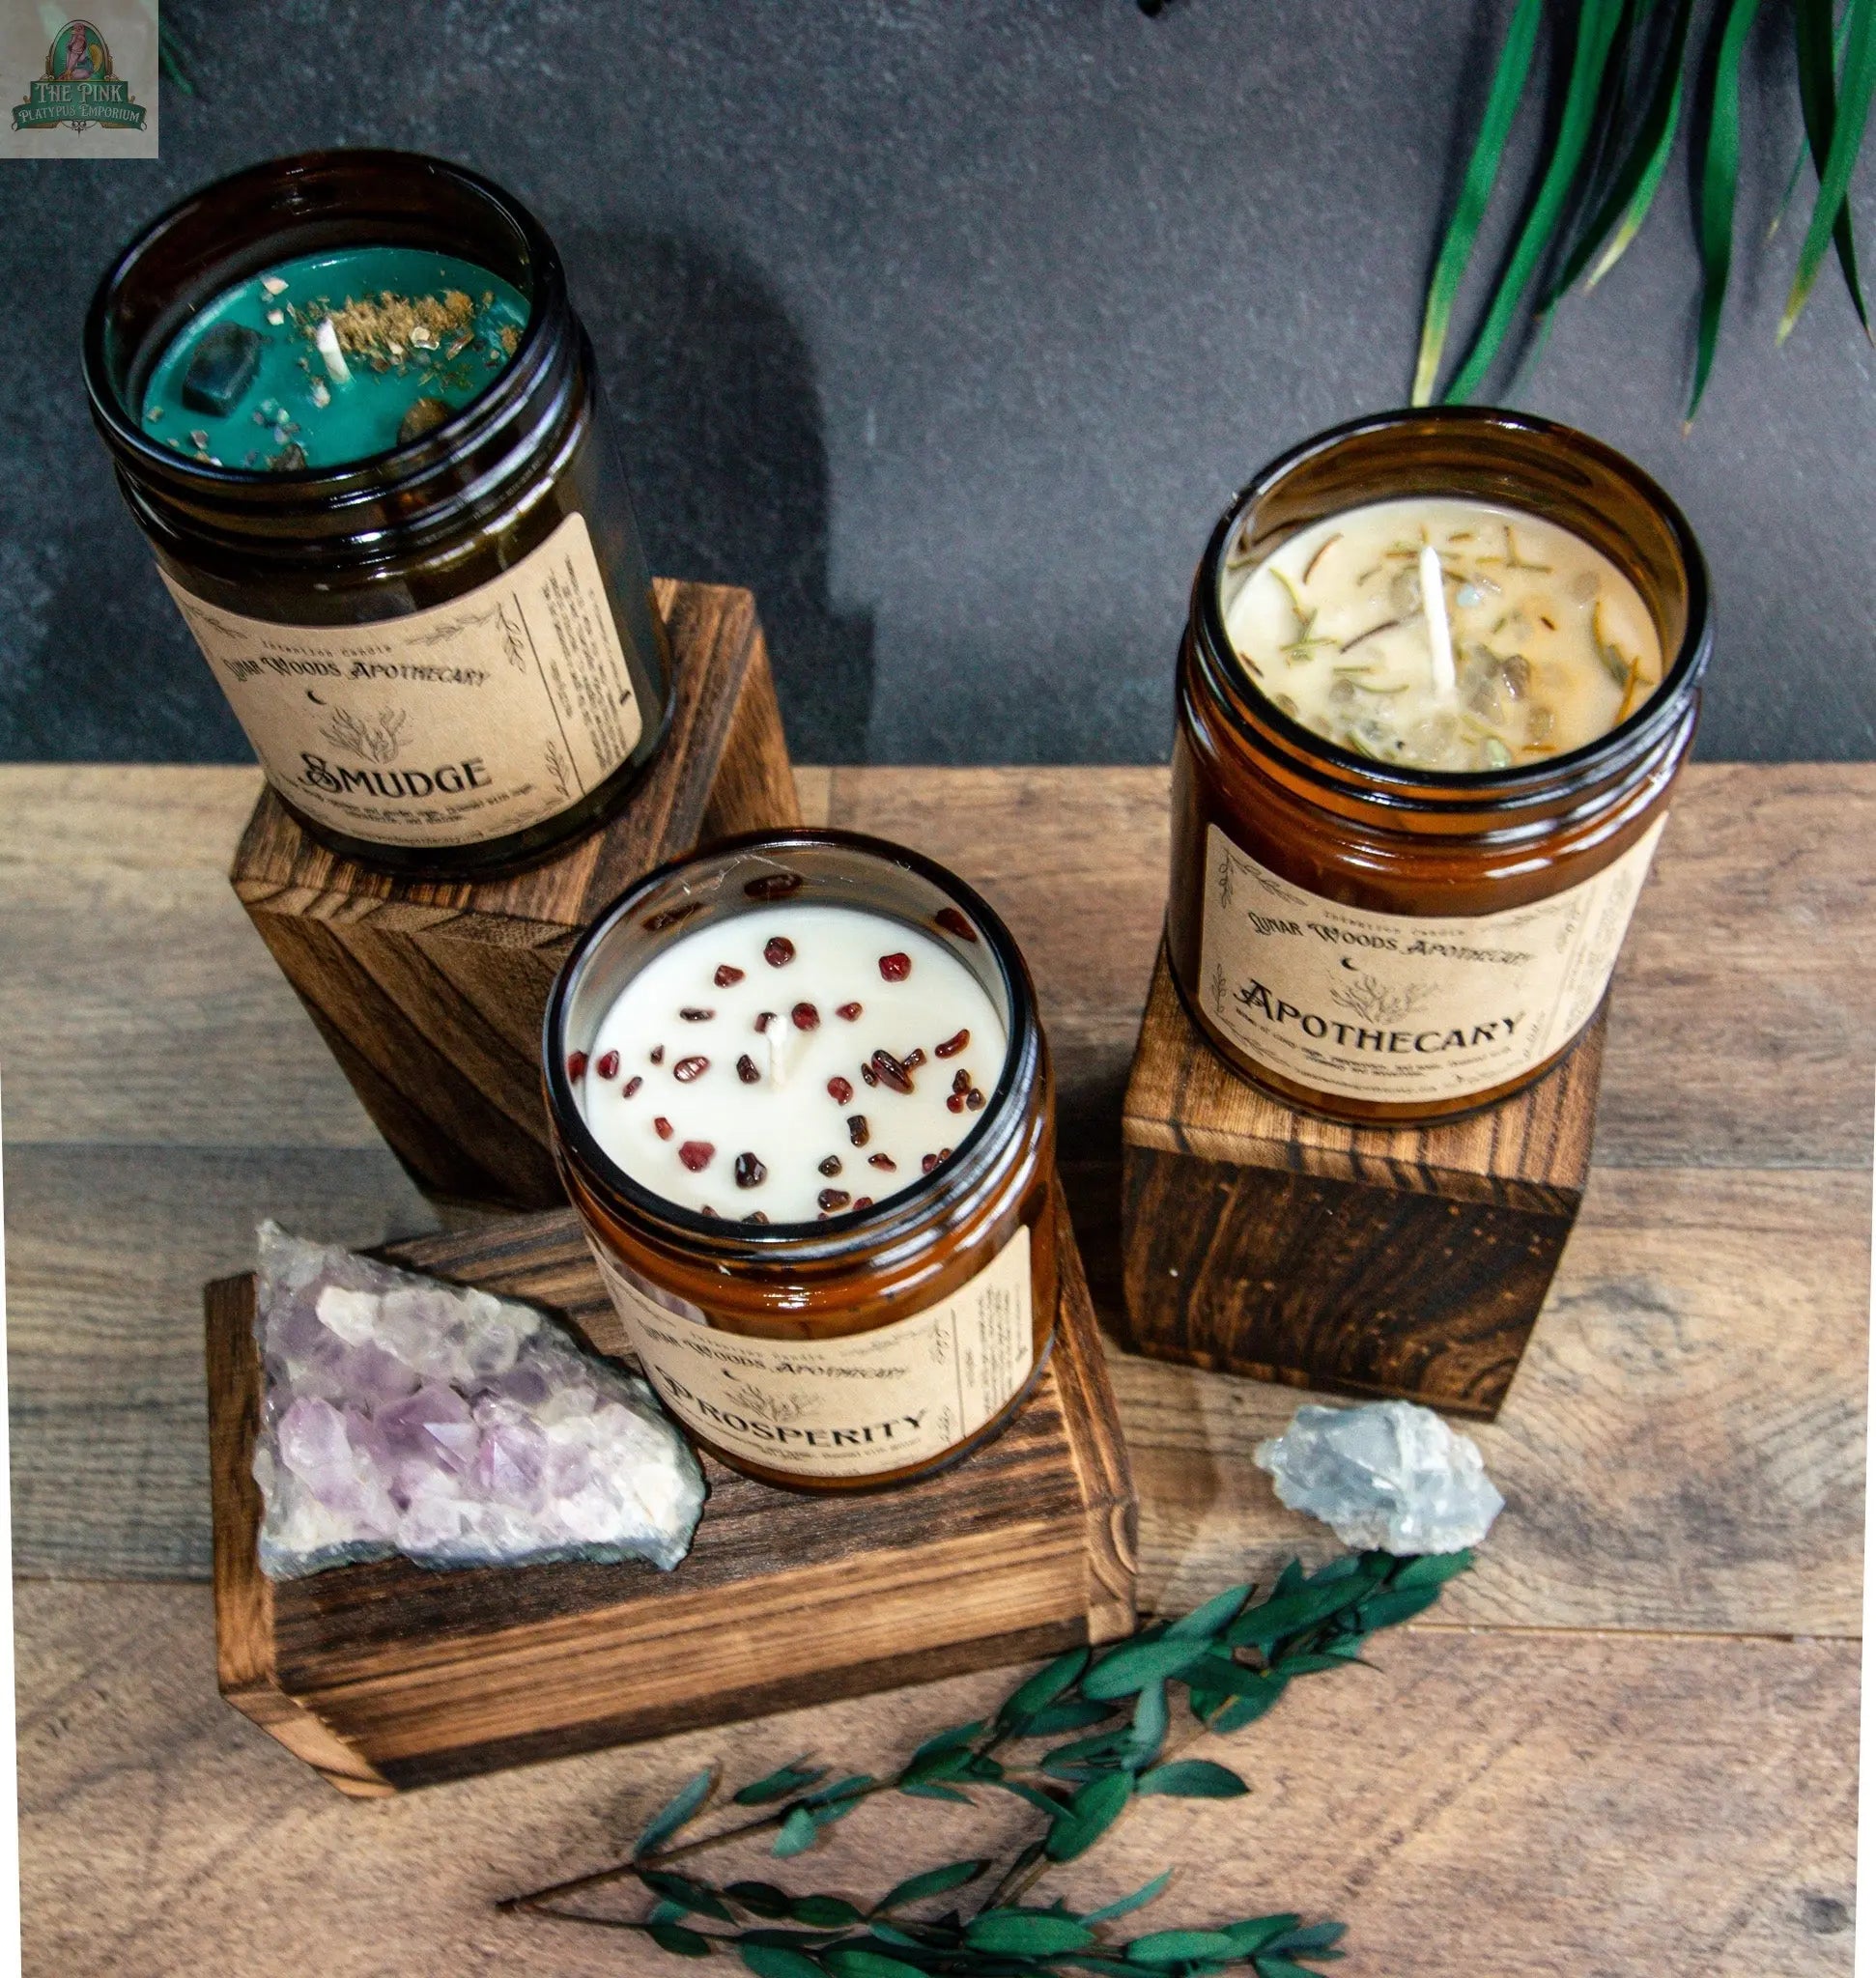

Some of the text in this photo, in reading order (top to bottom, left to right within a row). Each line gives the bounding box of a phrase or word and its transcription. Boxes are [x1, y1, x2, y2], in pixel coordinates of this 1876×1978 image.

[297, 750, 493, 799] SMUDGE
[1247, 911, 1305, 937] LUNAR
[1307, 919, 1399, 951] WOODS
[1233, 977, 1527, 1054] APOTHECARY
[654, 1365, 927, 1449] PROSPERITY
